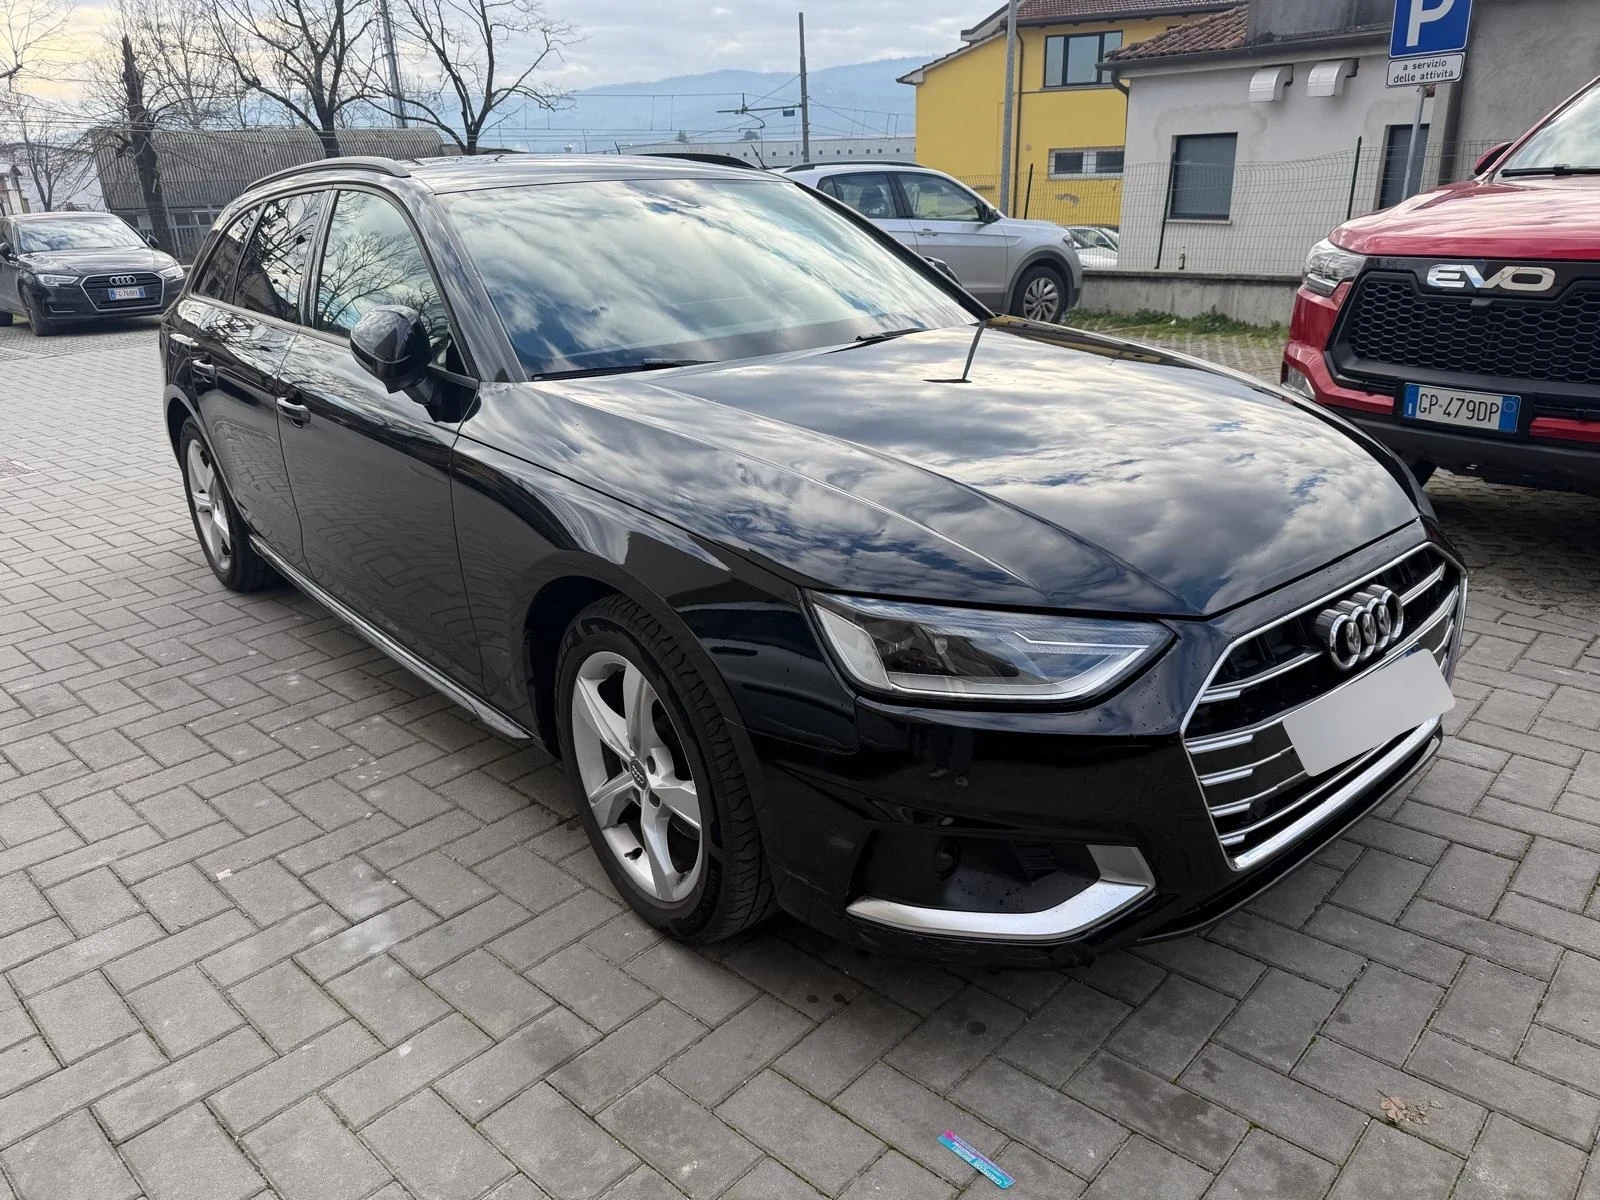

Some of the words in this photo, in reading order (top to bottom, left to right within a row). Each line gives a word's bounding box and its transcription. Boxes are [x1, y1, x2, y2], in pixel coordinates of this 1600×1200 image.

[1405, 0, 1456, 47] P
[1393, 73, 1416, 84] delle
[1419, 67, 1454, 81] attività
[1402, 63, 1408, 71] a
[1412, 59, 1447, 70] servizio
[1426, 263, 1556, 291] EVO
